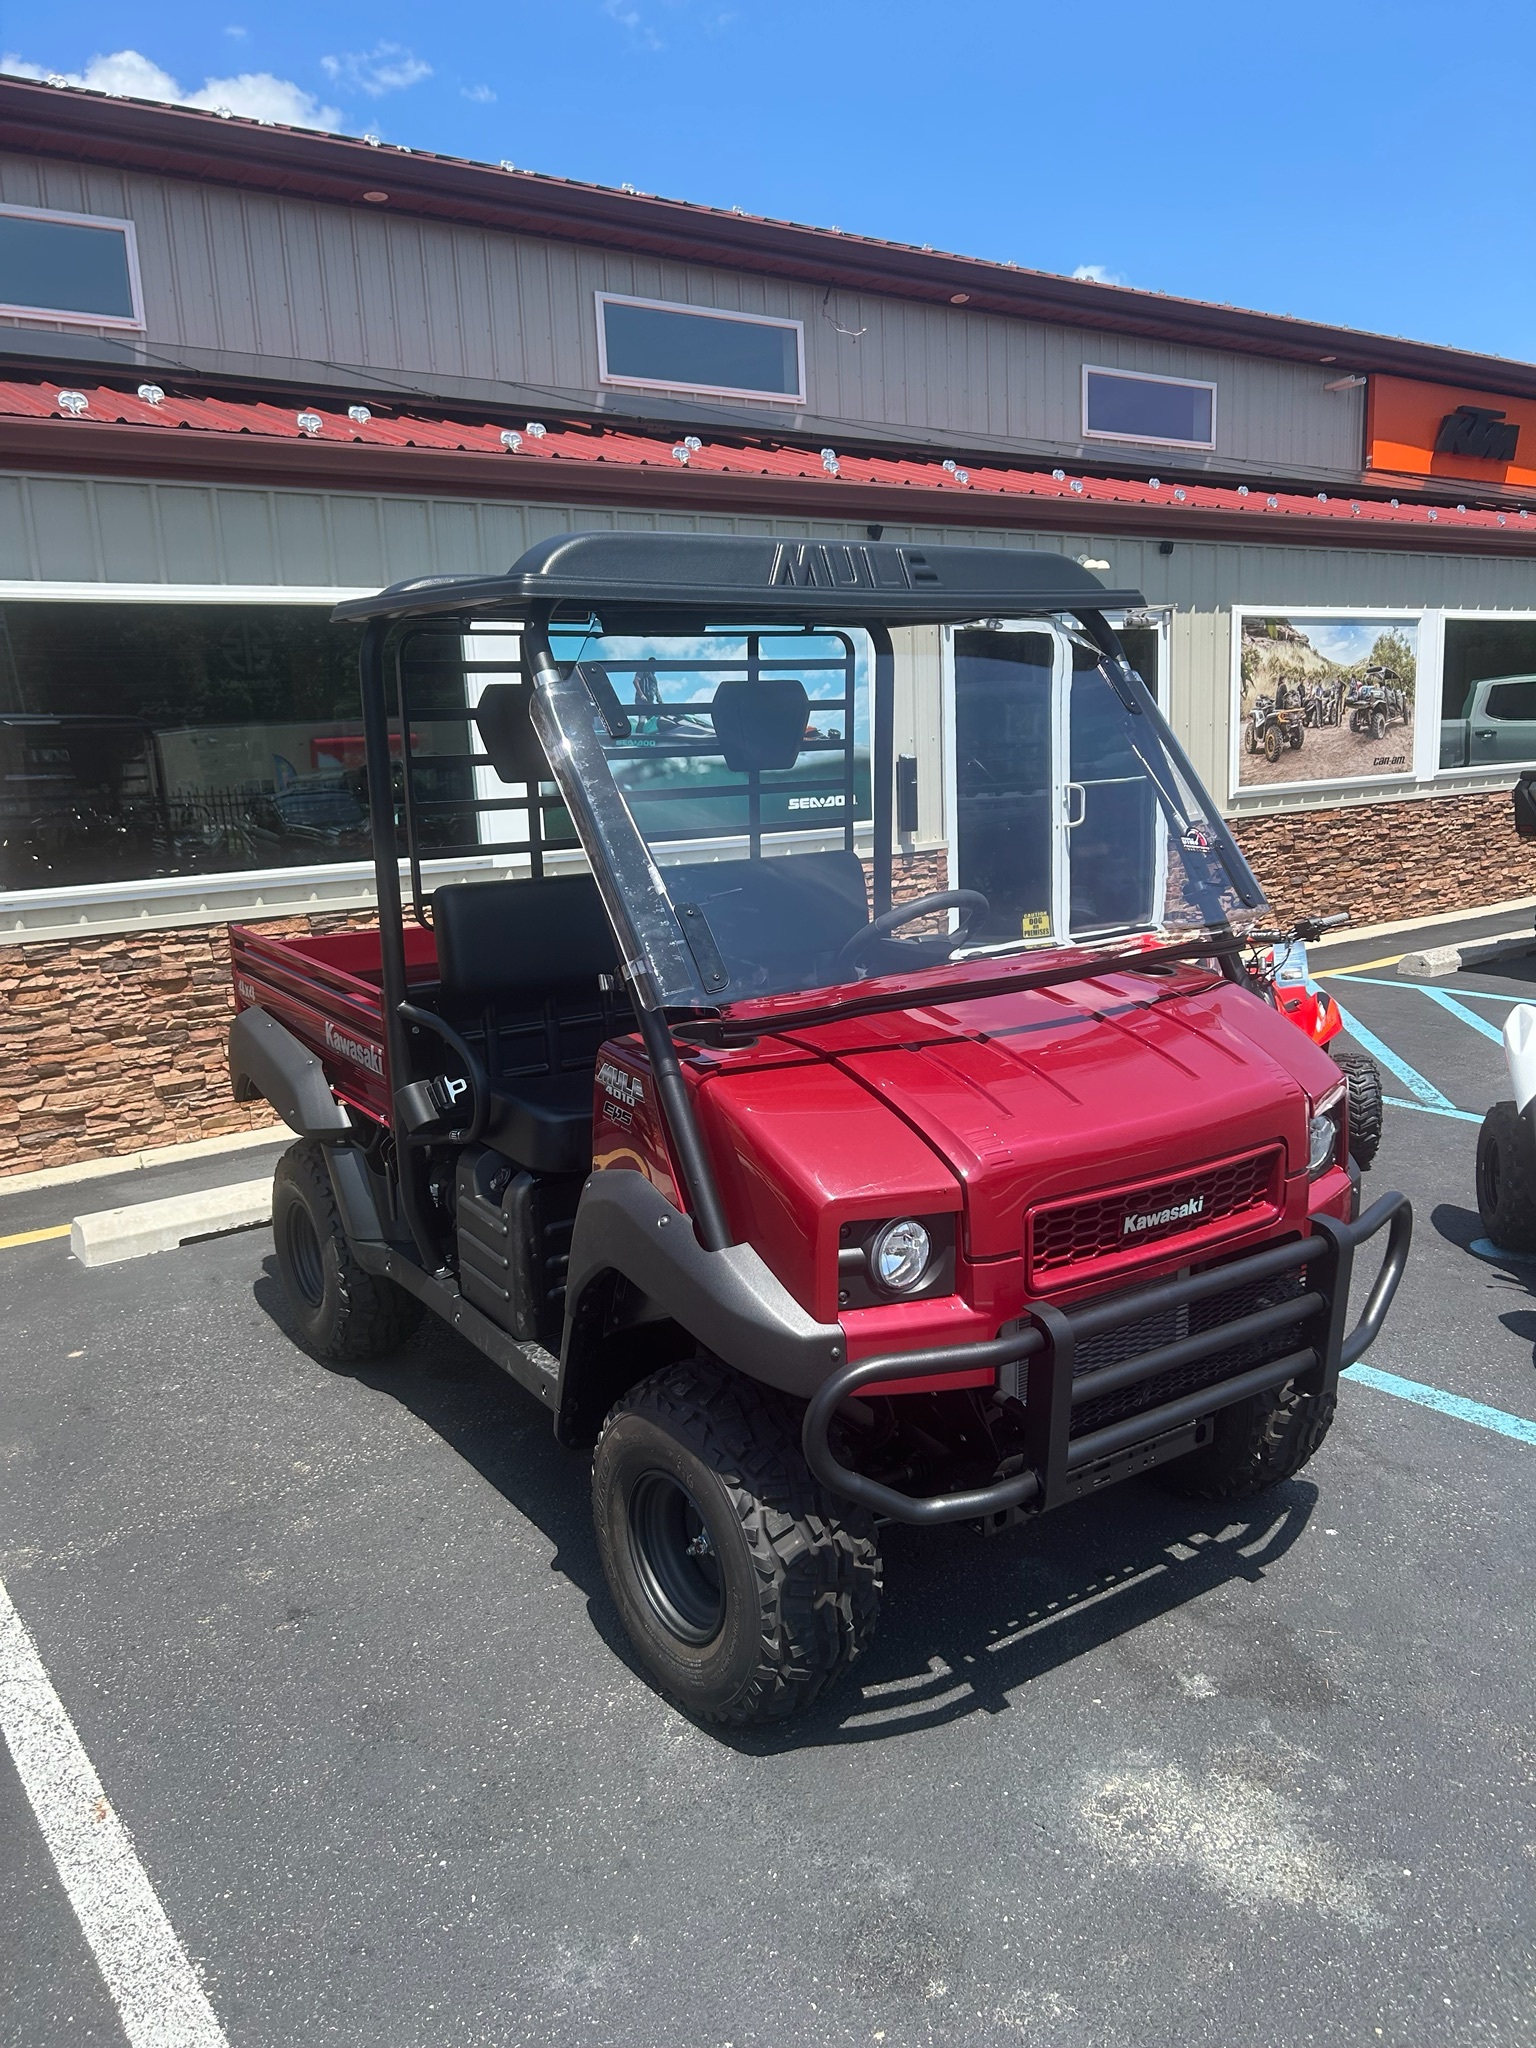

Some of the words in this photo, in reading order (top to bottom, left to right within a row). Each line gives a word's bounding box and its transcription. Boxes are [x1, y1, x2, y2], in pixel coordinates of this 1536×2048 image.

[1434, 405, 1520, 461] KTM
[767, 542, 943, 590] MULE
[1024, 928, 1050, 936] PREMISES
[1029, 917, 1043, 925] DOG
[324, 1020, 384, 1075] Kawasaki
[597, 1062, 646, 1103] MULE
[605, 1085, 636, 1107] 4010
[1123, 1194, 1204, 1235] Kawasaki
